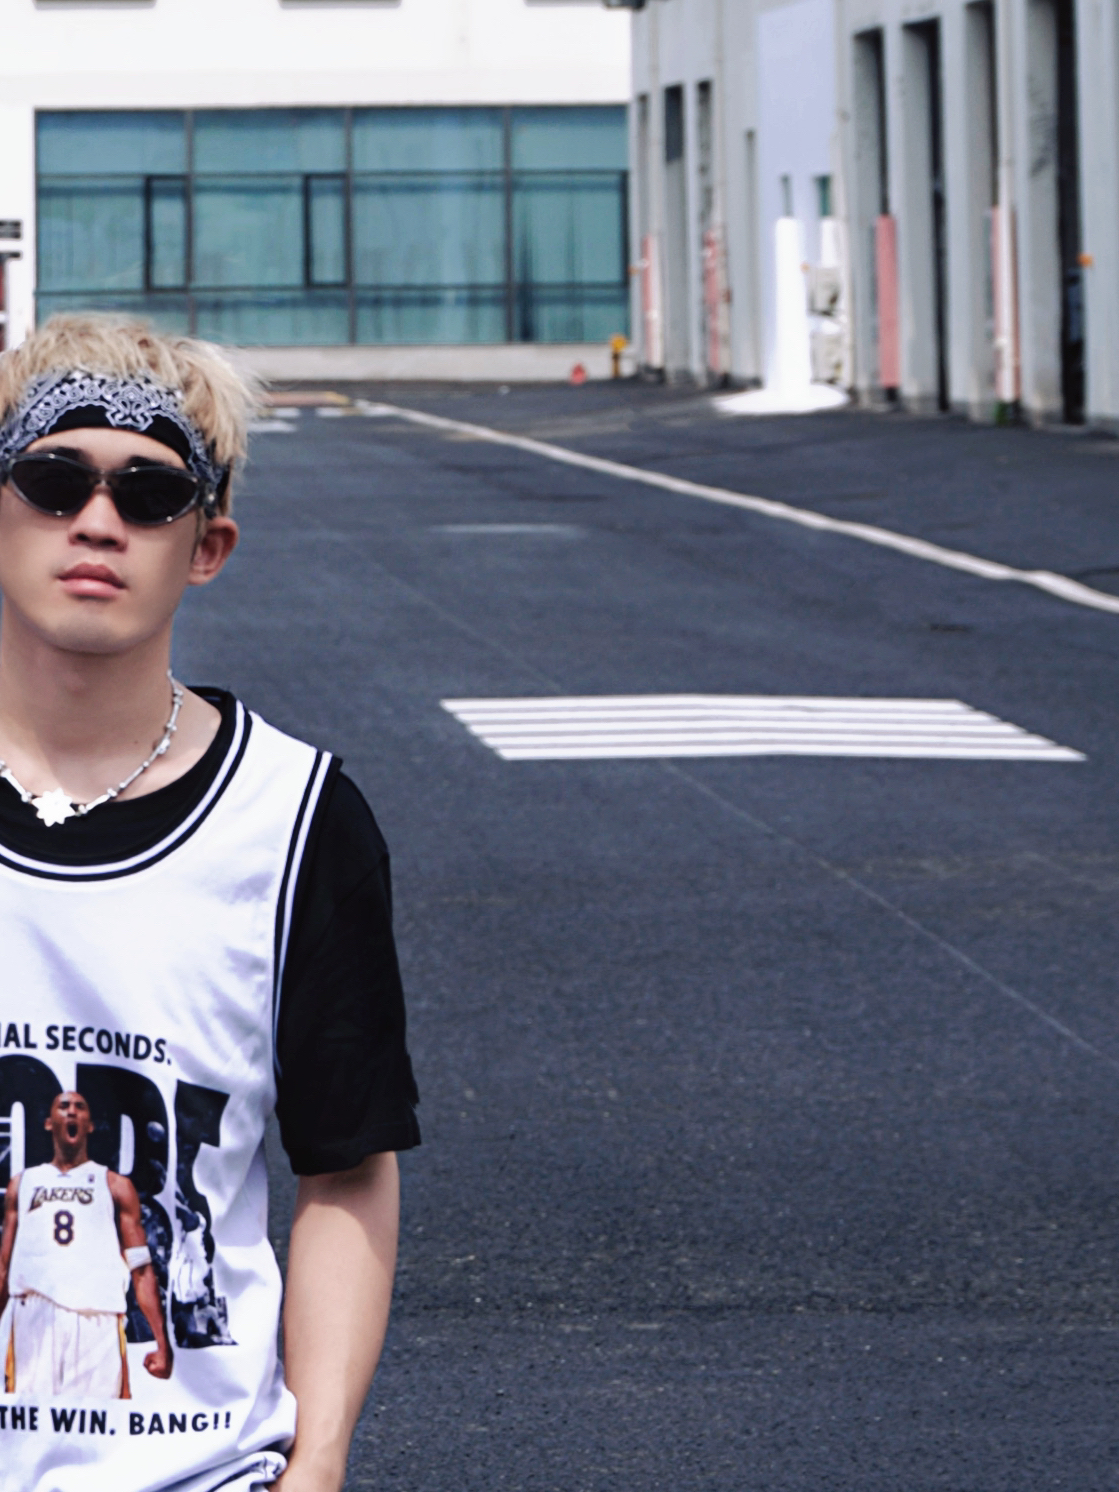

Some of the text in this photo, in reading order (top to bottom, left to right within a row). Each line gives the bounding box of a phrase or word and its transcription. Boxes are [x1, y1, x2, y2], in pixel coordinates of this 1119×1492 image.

[45, 1025, 172, 1066] SECONDS.
[28, 1186, 95, 1213] LAKERS
[53, 1209, 75, 1248] 8
[50, 1408, 116, 1436] WIN.
[129, 1411, 232, 1435] BANG!!
